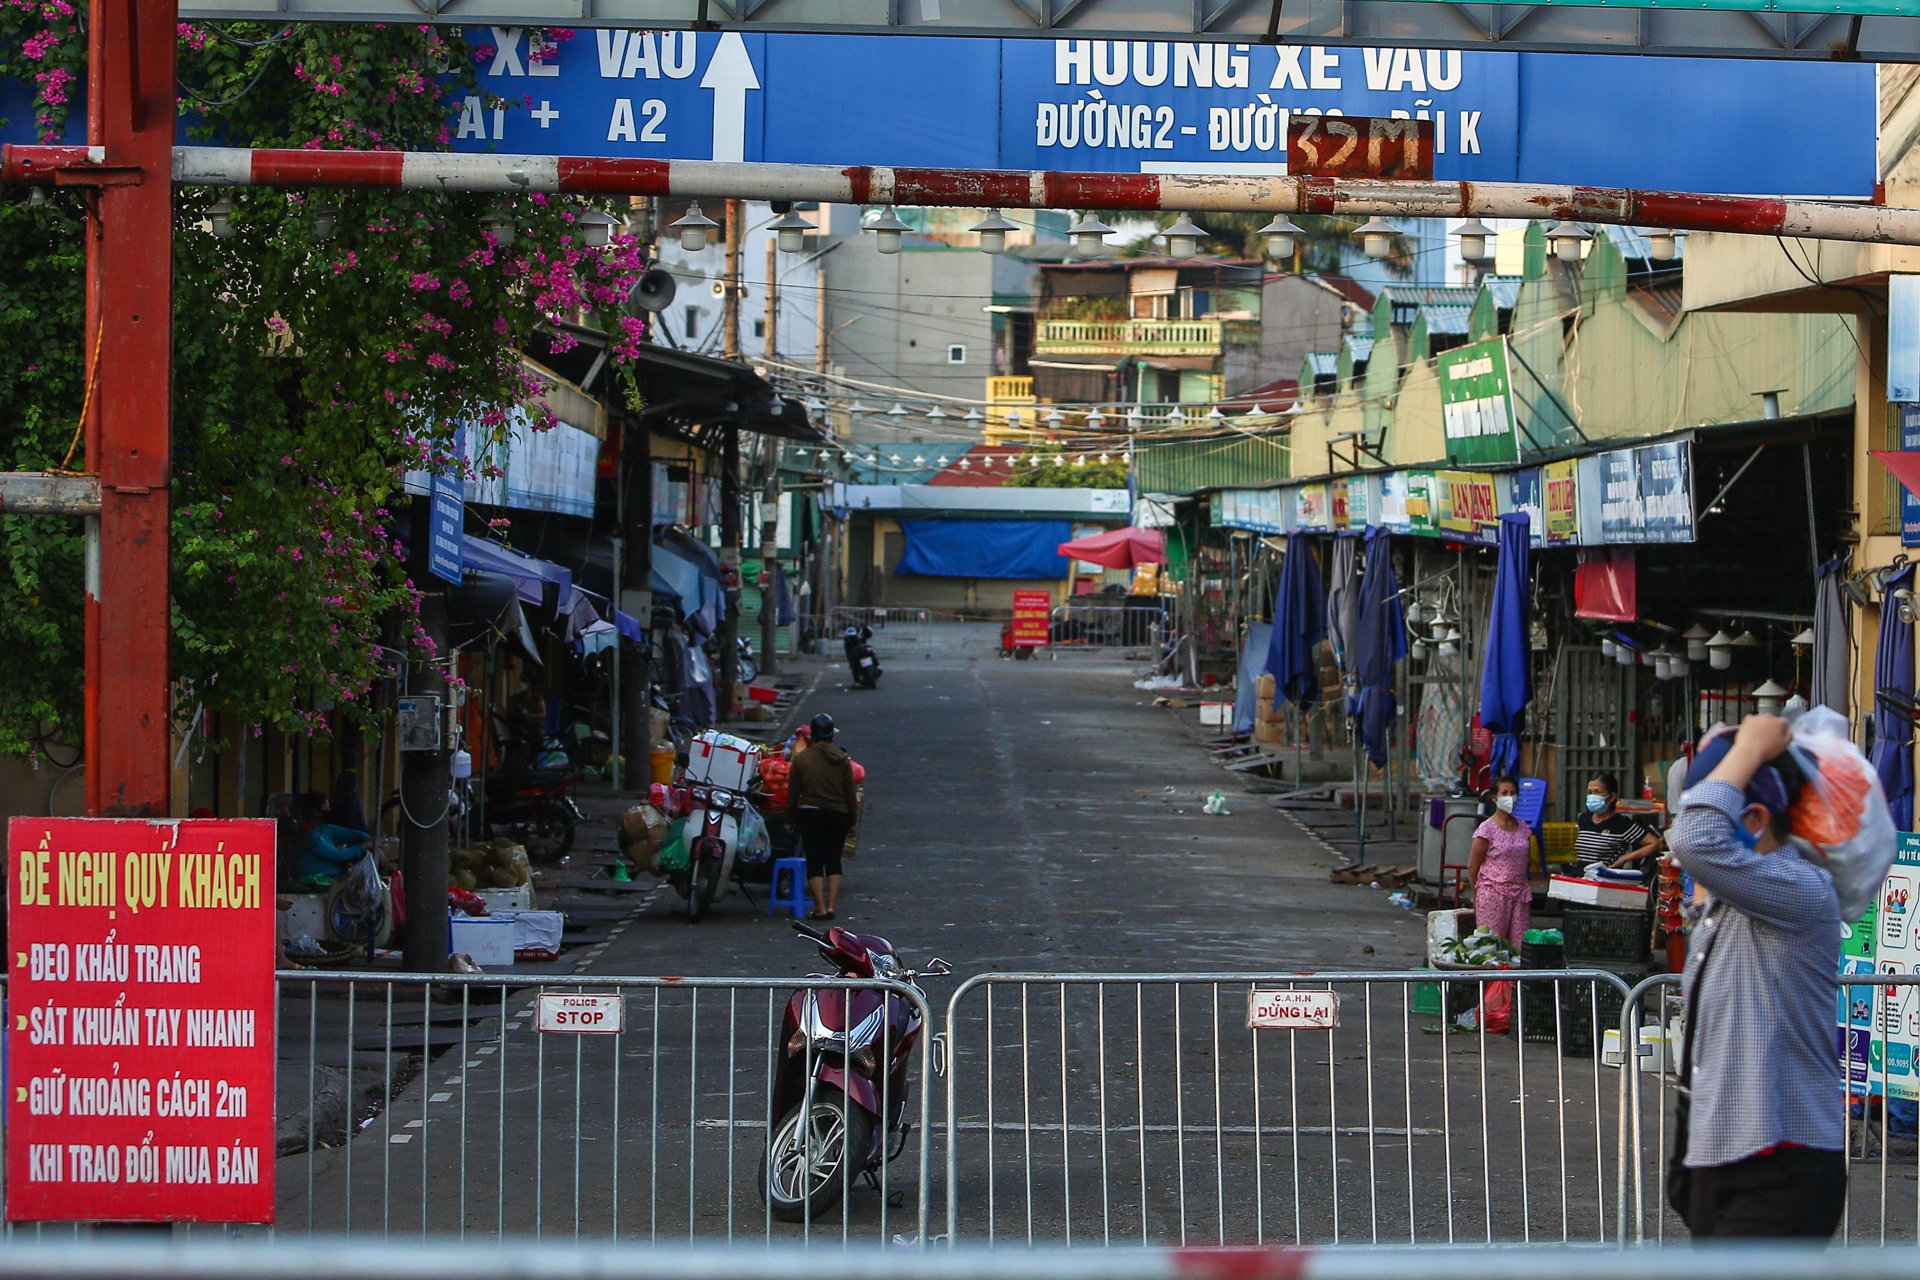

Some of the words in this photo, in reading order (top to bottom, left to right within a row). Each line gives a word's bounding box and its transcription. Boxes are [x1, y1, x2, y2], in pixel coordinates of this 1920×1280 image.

[1269, 45, 1342, 91] XE
[607, 98, 668, 143] A2
[1036, 88, 1175, 150] ĐƯỜNG2
[1460, 110, 1482, 155] K
[19, 830, 51, 907] ĐỀ
[59, 850, 117, 919] NGHỊ
[124, 841, 172, 914] QUÝ
[179, 842, 260, 909] KHÁCH
[30, 943, 70, 982] ĐEO
[75, 928, 130, 983] KHẨU
[135, 944, 201, 983] TRANG
[30, 999, 67, 1046] SÁT
[73, 992, 139, 1047] KHUẨN
[145, 1008, 181, 1047] TAY
[187, 1008, 255, 1048] NHANH
[556, 1011, 604, 1025] STOP
[563, 999, 598, 1007] POLICE
[1257, 1003, 1300, 1018] DỪNG
[1304, 1007, 1329, 1021] LẠI
[30, 1067, 67, 1116] GIỮ
[69, 1061, 151, 1117] KHOẢNG
[156, 1071, 210, 1117] CÁCH
[216, 1079, 247, 1118] 2m
[30, 1143, 63, 1182] KHI
[69, 1144, 120, 1183] TRAO
[125, 1130, 160, 1184] ĐỔI
[166, 1145, 211, 1184] MUA
[217, 1138, 259, 1185] BÁN
